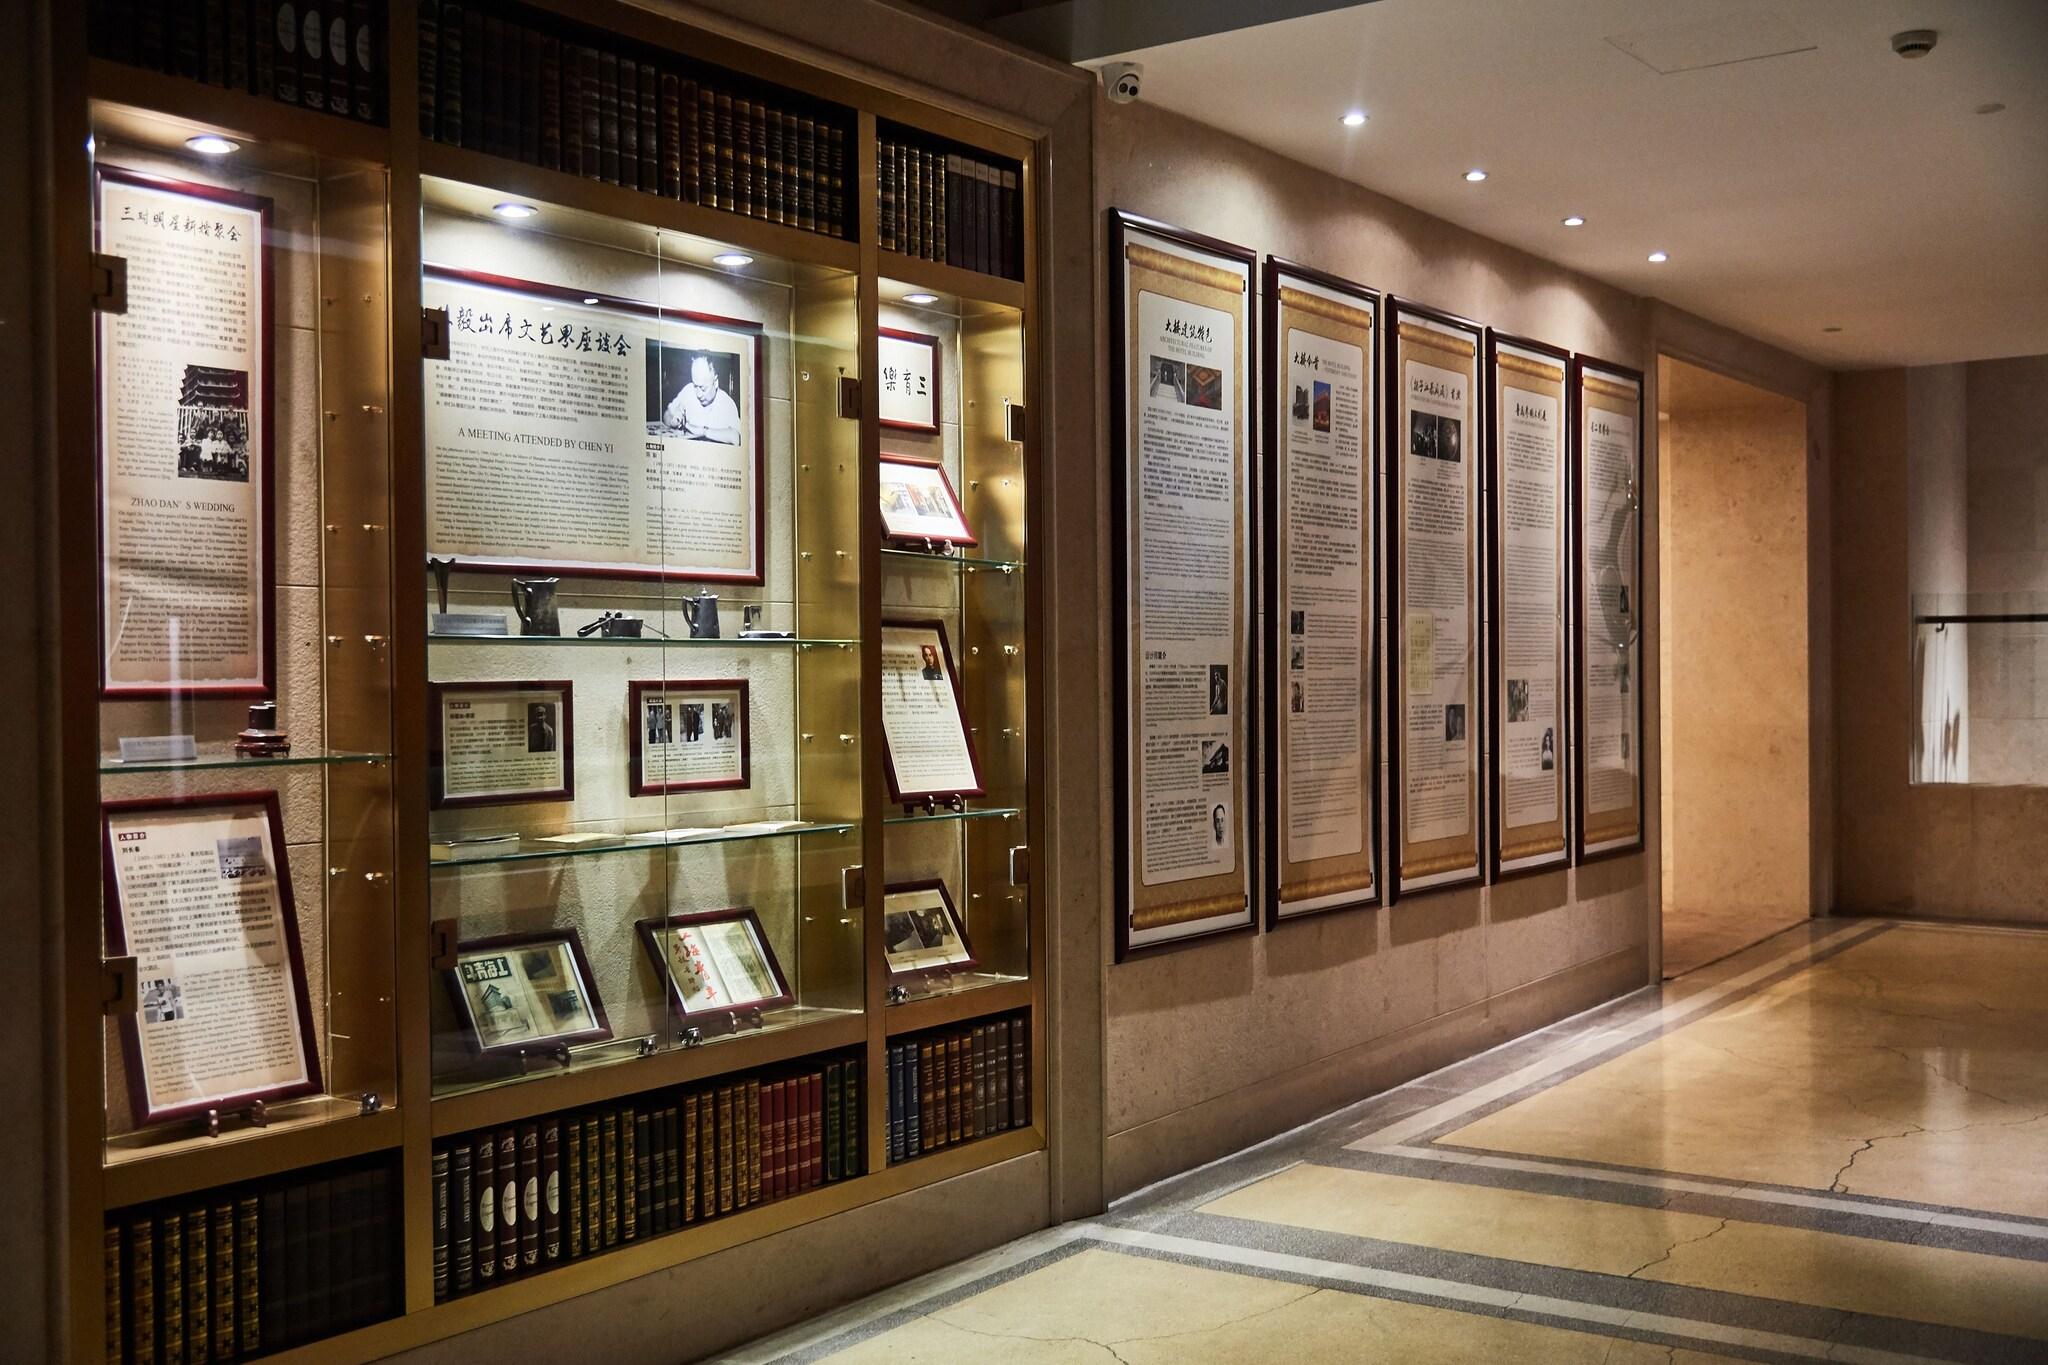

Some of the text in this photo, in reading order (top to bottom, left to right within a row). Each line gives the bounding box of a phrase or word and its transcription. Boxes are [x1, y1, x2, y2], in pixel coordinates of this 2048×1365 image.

[458, 427, 614, 454] A MEETING ATTENDED BY CHEN YI
[131, 497, 157, 507] ZHAO
[193, 502, 235, 513] WEDDING
